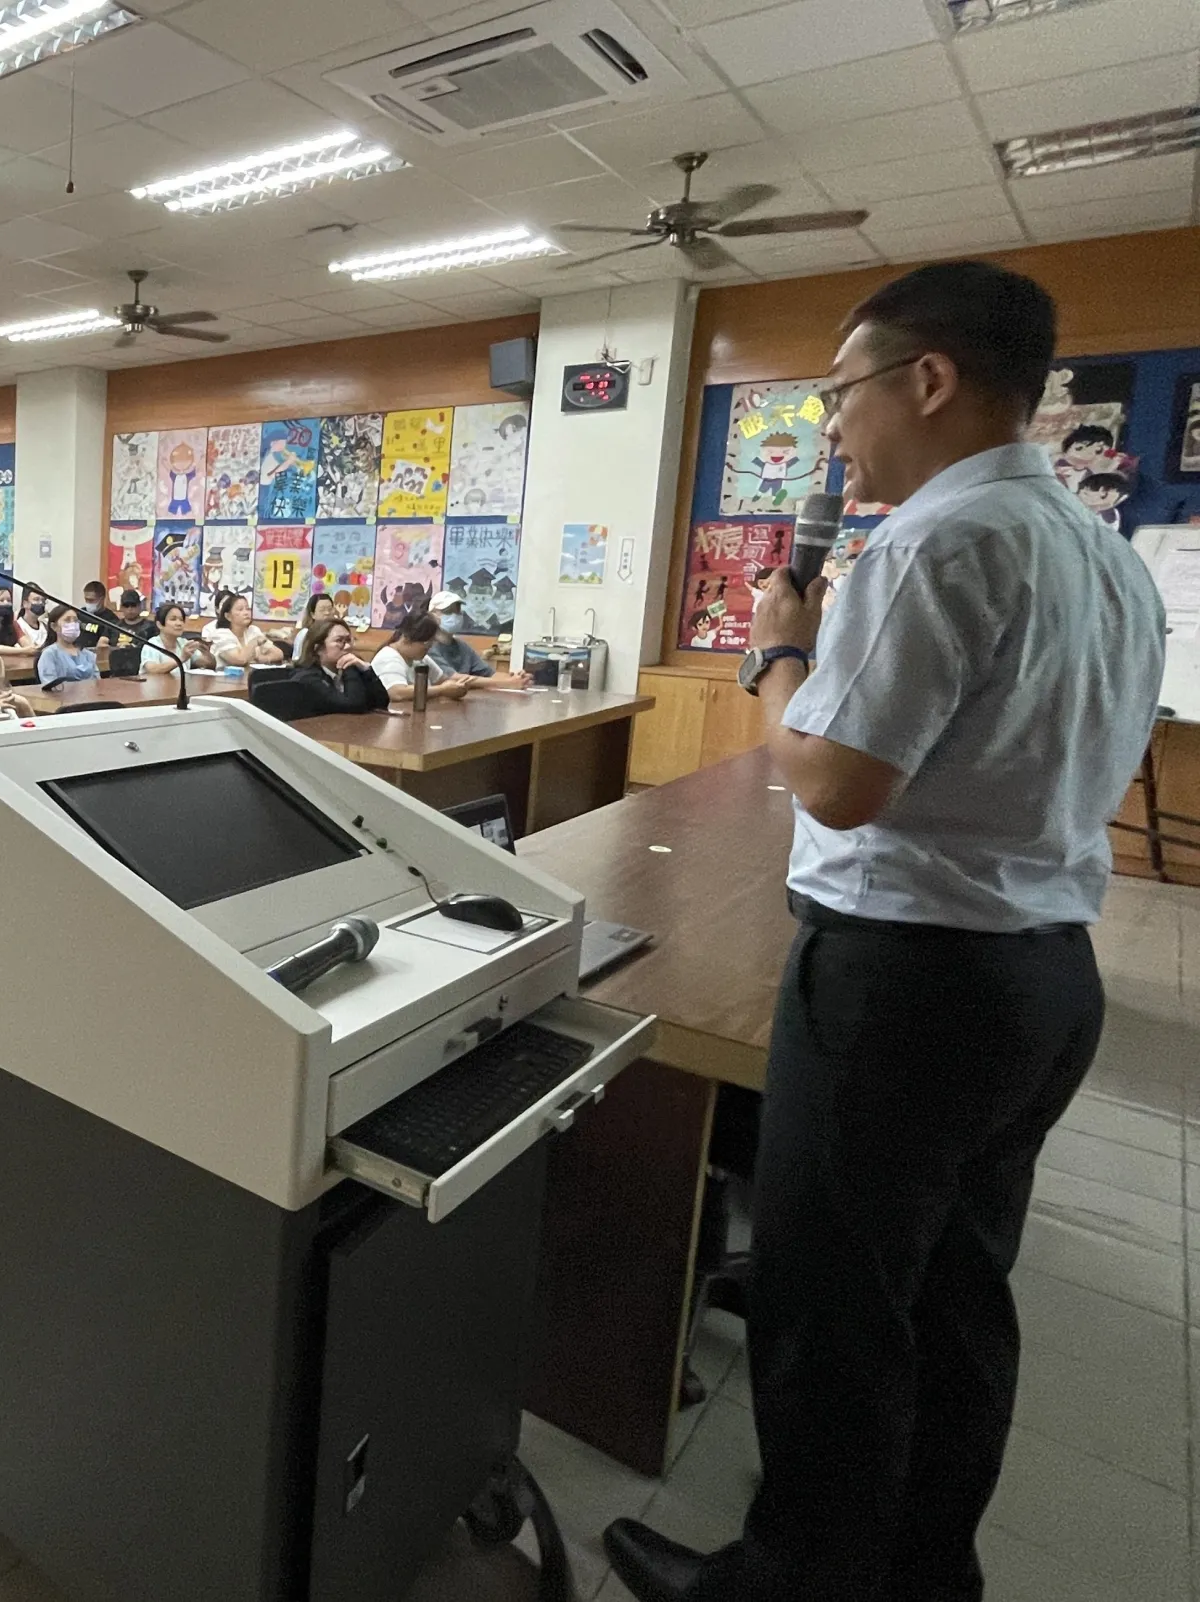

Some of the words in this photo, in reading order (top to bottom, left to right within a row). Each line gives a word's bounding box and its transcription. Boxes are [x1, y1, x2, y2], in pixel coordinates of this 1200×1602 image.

[286, 427, 313, 448] 20
[449, 525, 514, 549] 畢業快樂
[272, 560, 294, 589] 19
